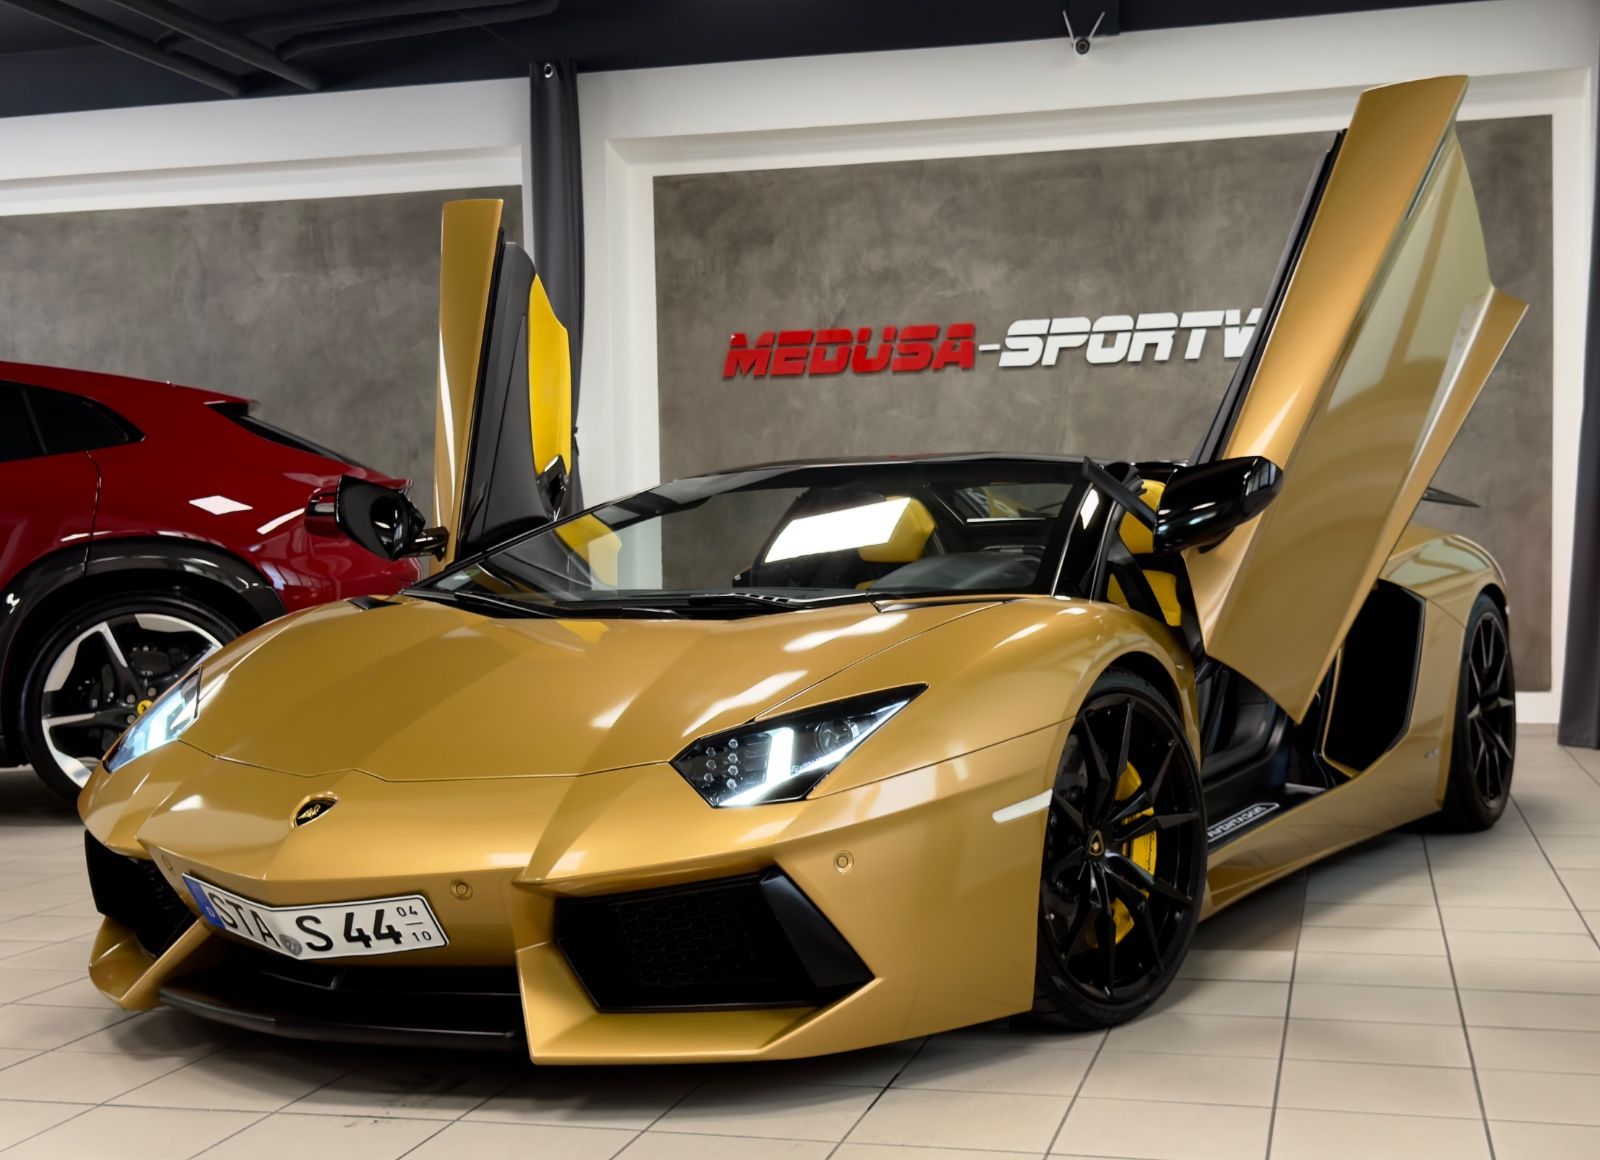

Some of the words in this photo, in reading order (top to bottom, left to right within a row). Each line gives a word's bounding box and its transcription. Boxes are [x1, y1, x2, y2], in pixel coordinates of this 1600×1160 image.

[396, 905, 418, 917] 04
[208, 891, 281, 948] STA
[412, 931, 432, 942] 10
